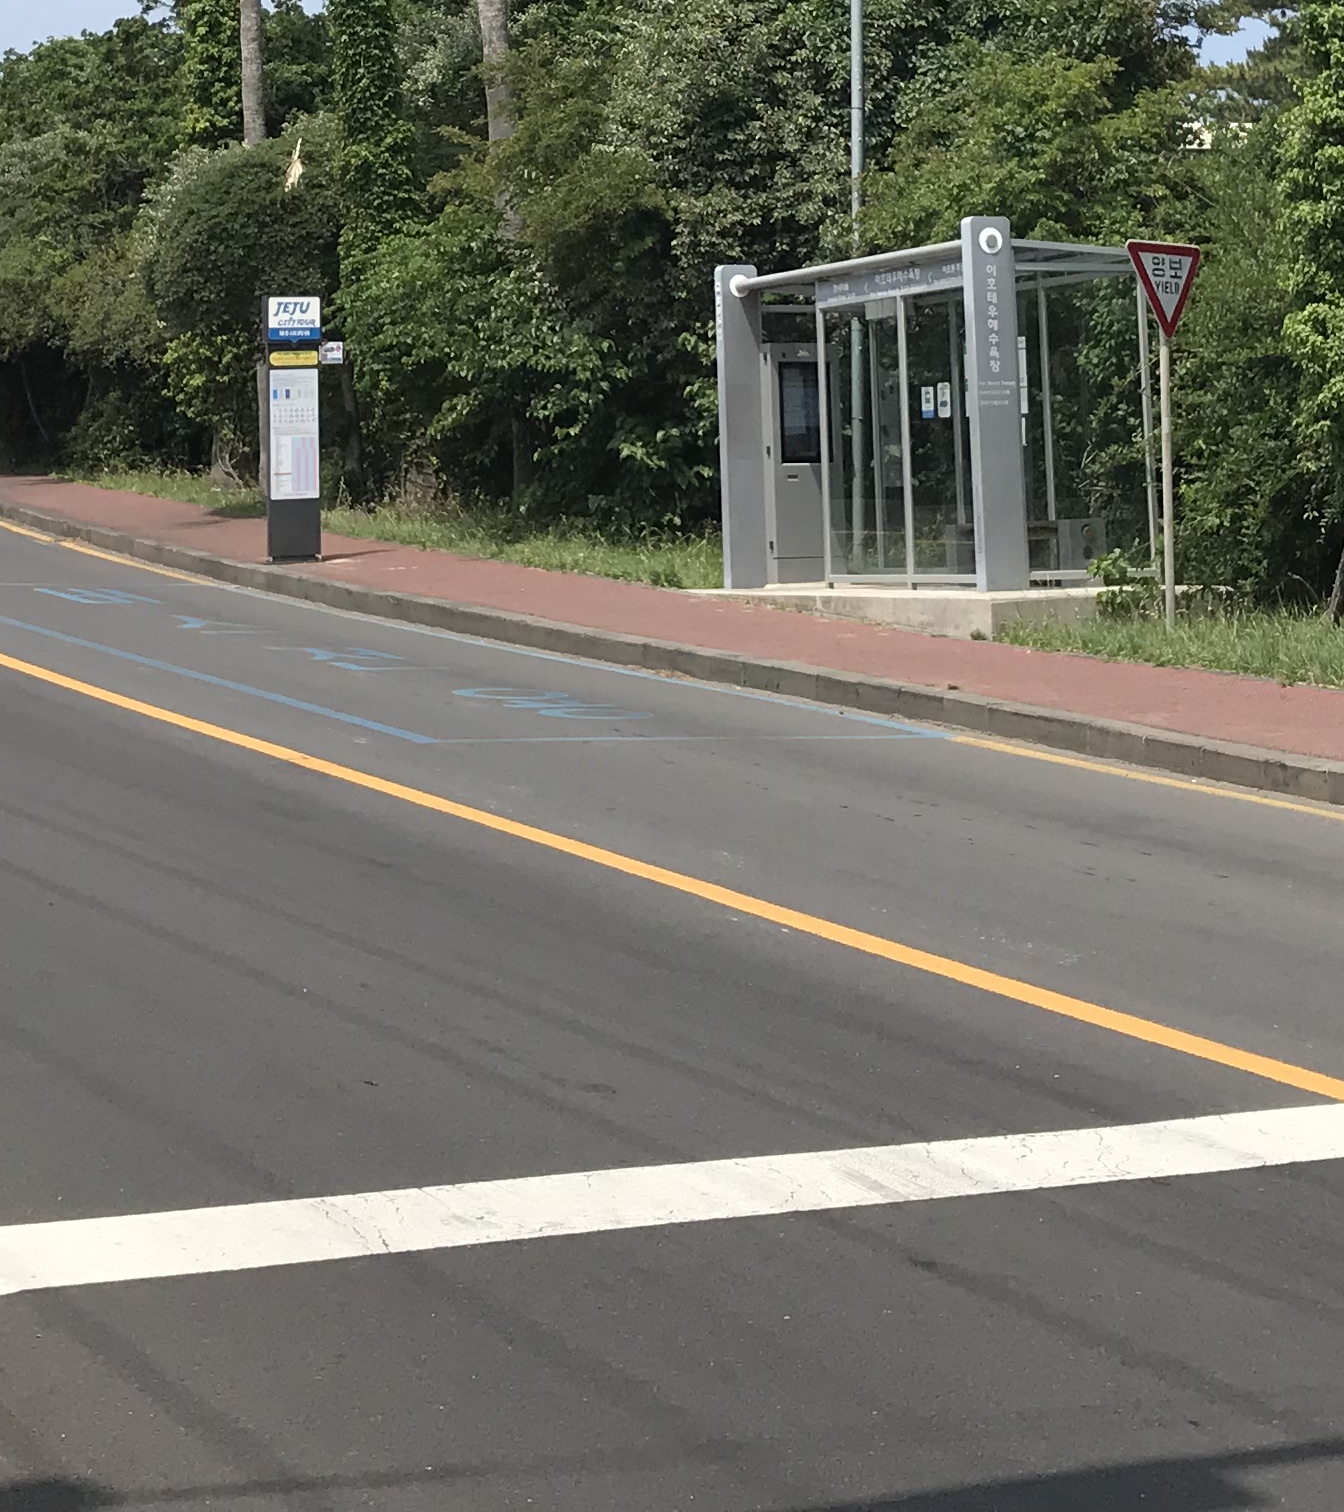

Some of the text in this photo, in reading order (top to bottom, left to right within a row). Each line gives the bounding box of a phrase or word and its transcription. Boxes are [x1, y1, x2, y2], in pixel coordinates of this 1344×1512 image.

[1152, 256, 1183, 279] 양보
[1155, 280, 1180, 295] YIELD
[273, 301, 311, 317] JEJU
[986, 264, 1002, 373] 이호테우해수욕장
